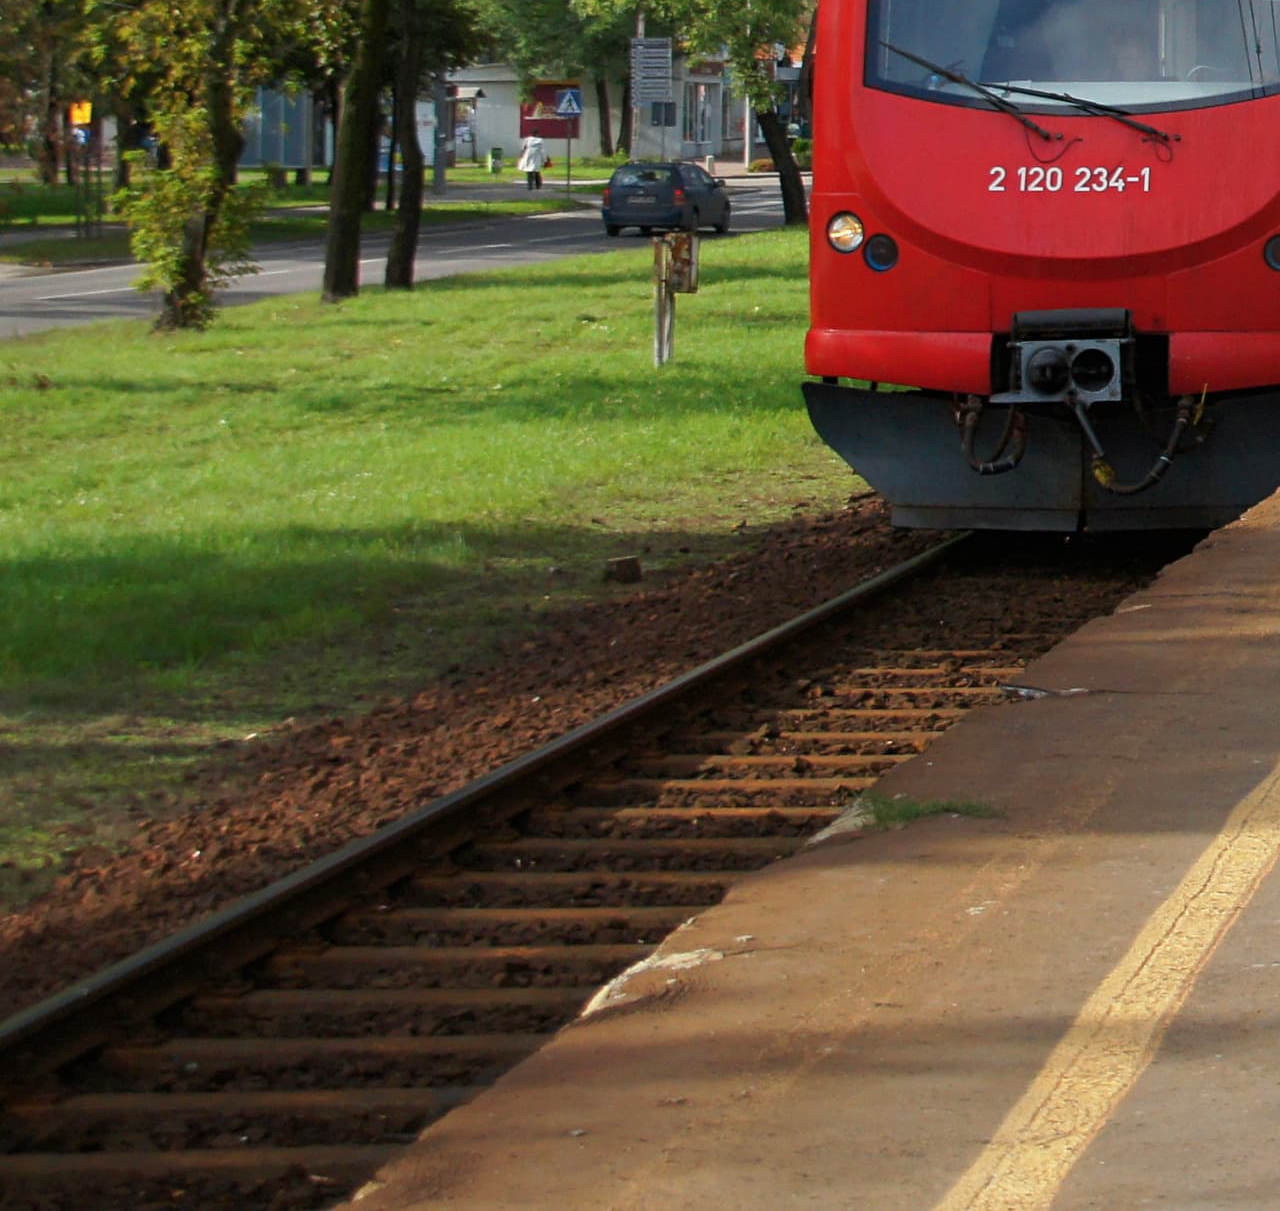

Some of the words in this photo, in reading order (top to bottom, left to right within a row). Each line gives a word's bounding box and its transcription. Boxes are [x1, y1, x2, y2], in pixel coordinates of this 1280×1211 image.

[988, 166, 1006, 192] 2
[1017, 166, 1063, 192] 120
[1074, 166, 1151, 192] 234-1
